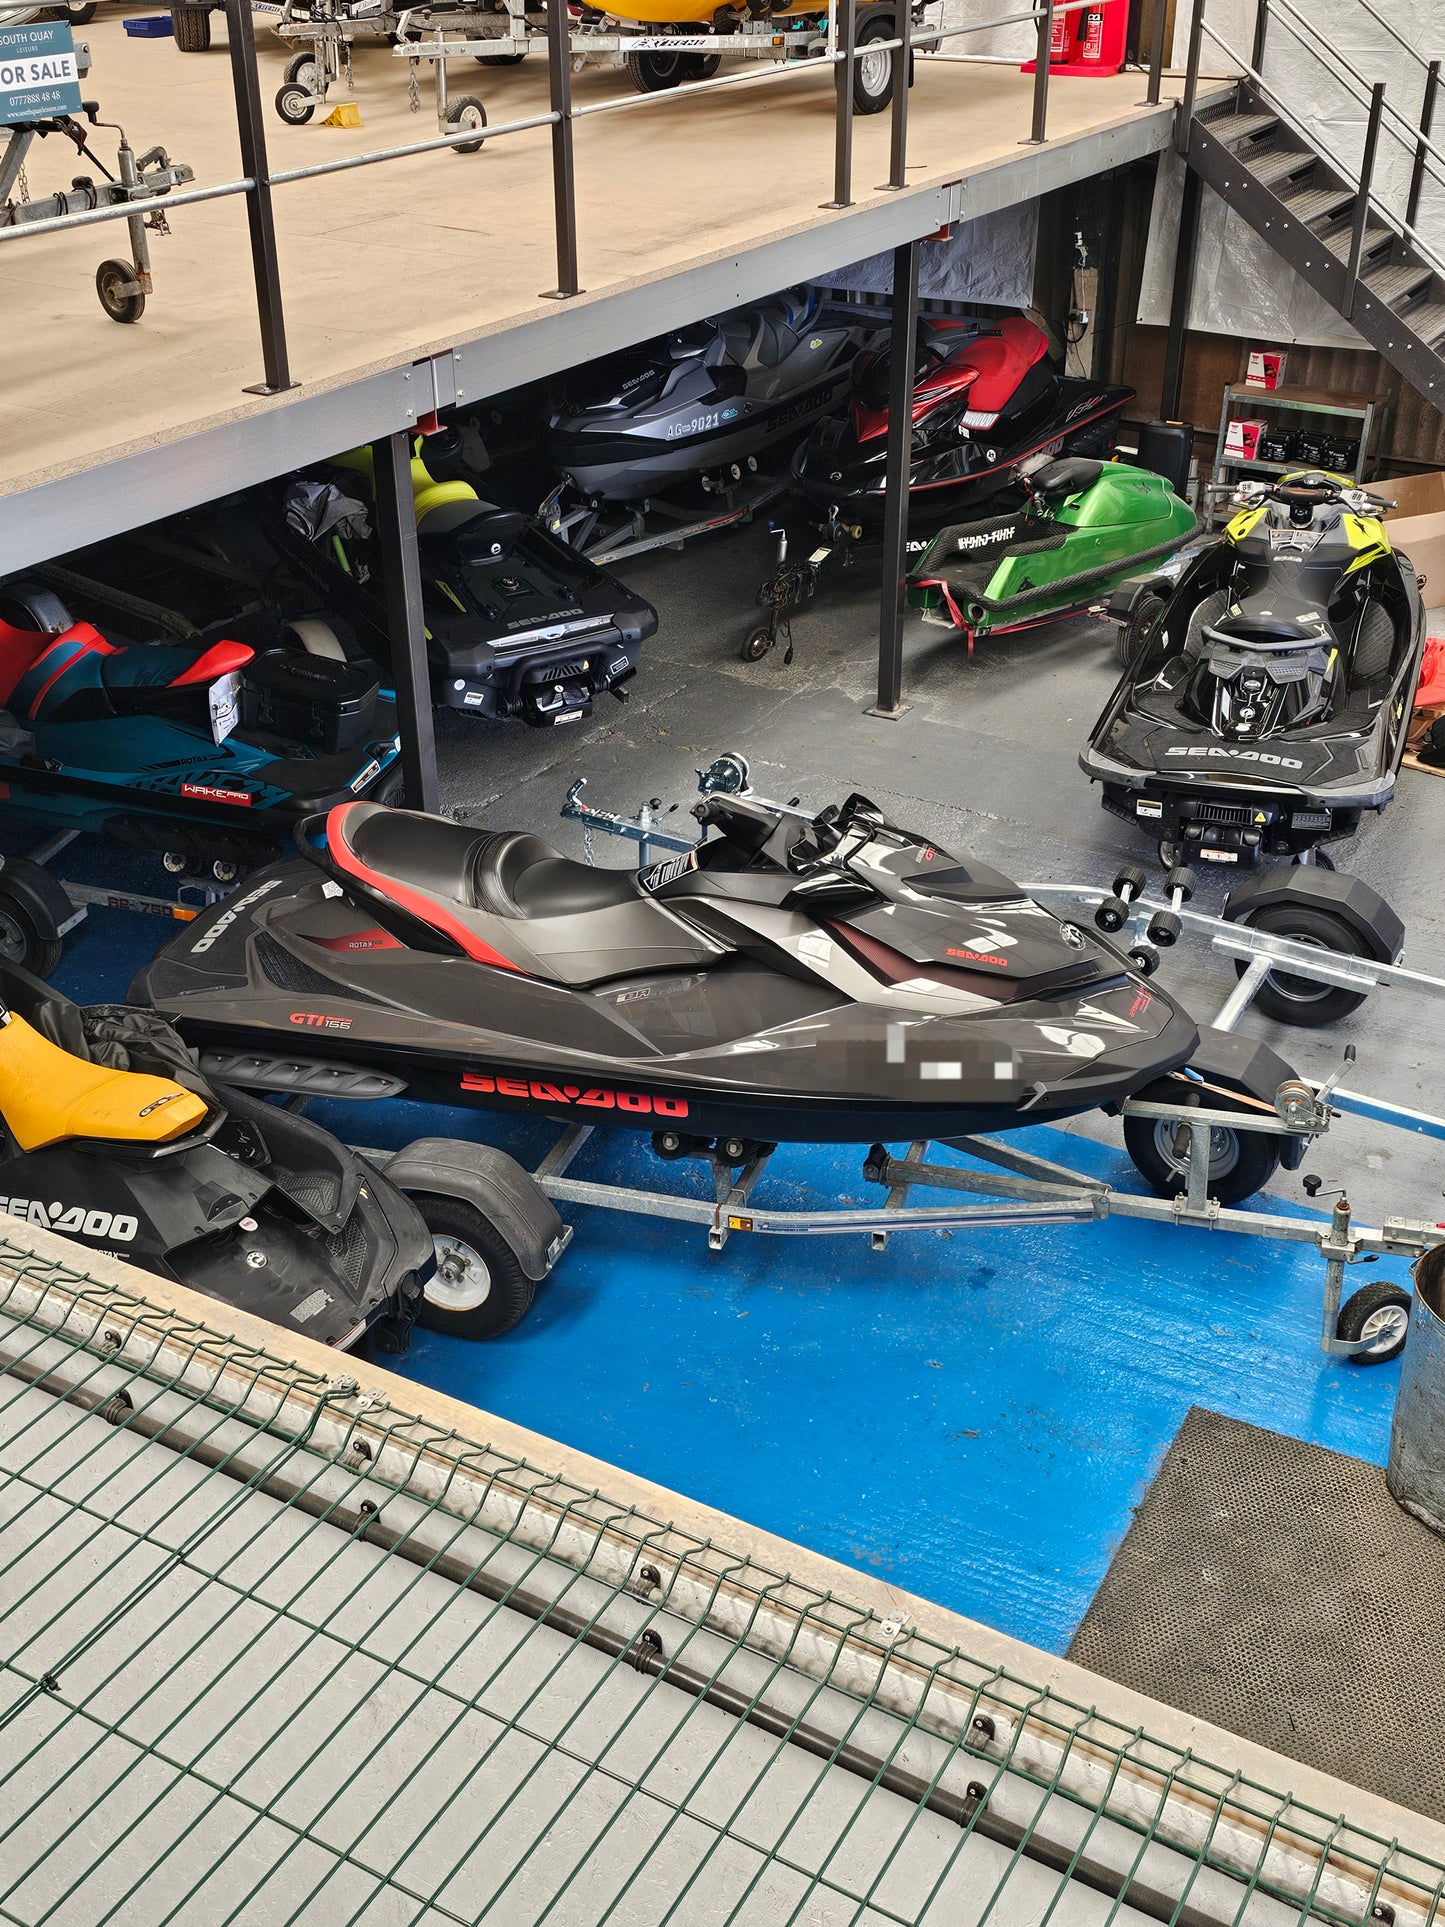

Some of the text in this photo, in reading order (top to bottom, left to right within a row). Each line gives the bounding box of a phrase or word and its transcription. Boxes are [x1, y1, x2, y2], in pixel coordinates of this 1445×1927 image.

[0, 30, 54, 46] SOUTH QUAY
[16, 45, 38, 54] LEISURE
[0, 60, 71, 85] OR SALE
[9, 90, 61, 106] 0777888 48 48
[180, 754, 209, 766] ROTAX
[349, 941, 373, 949] ROTAX
[289, 1012, 326, 1027] GTI
[325, 1019, 352, 1030] 155
